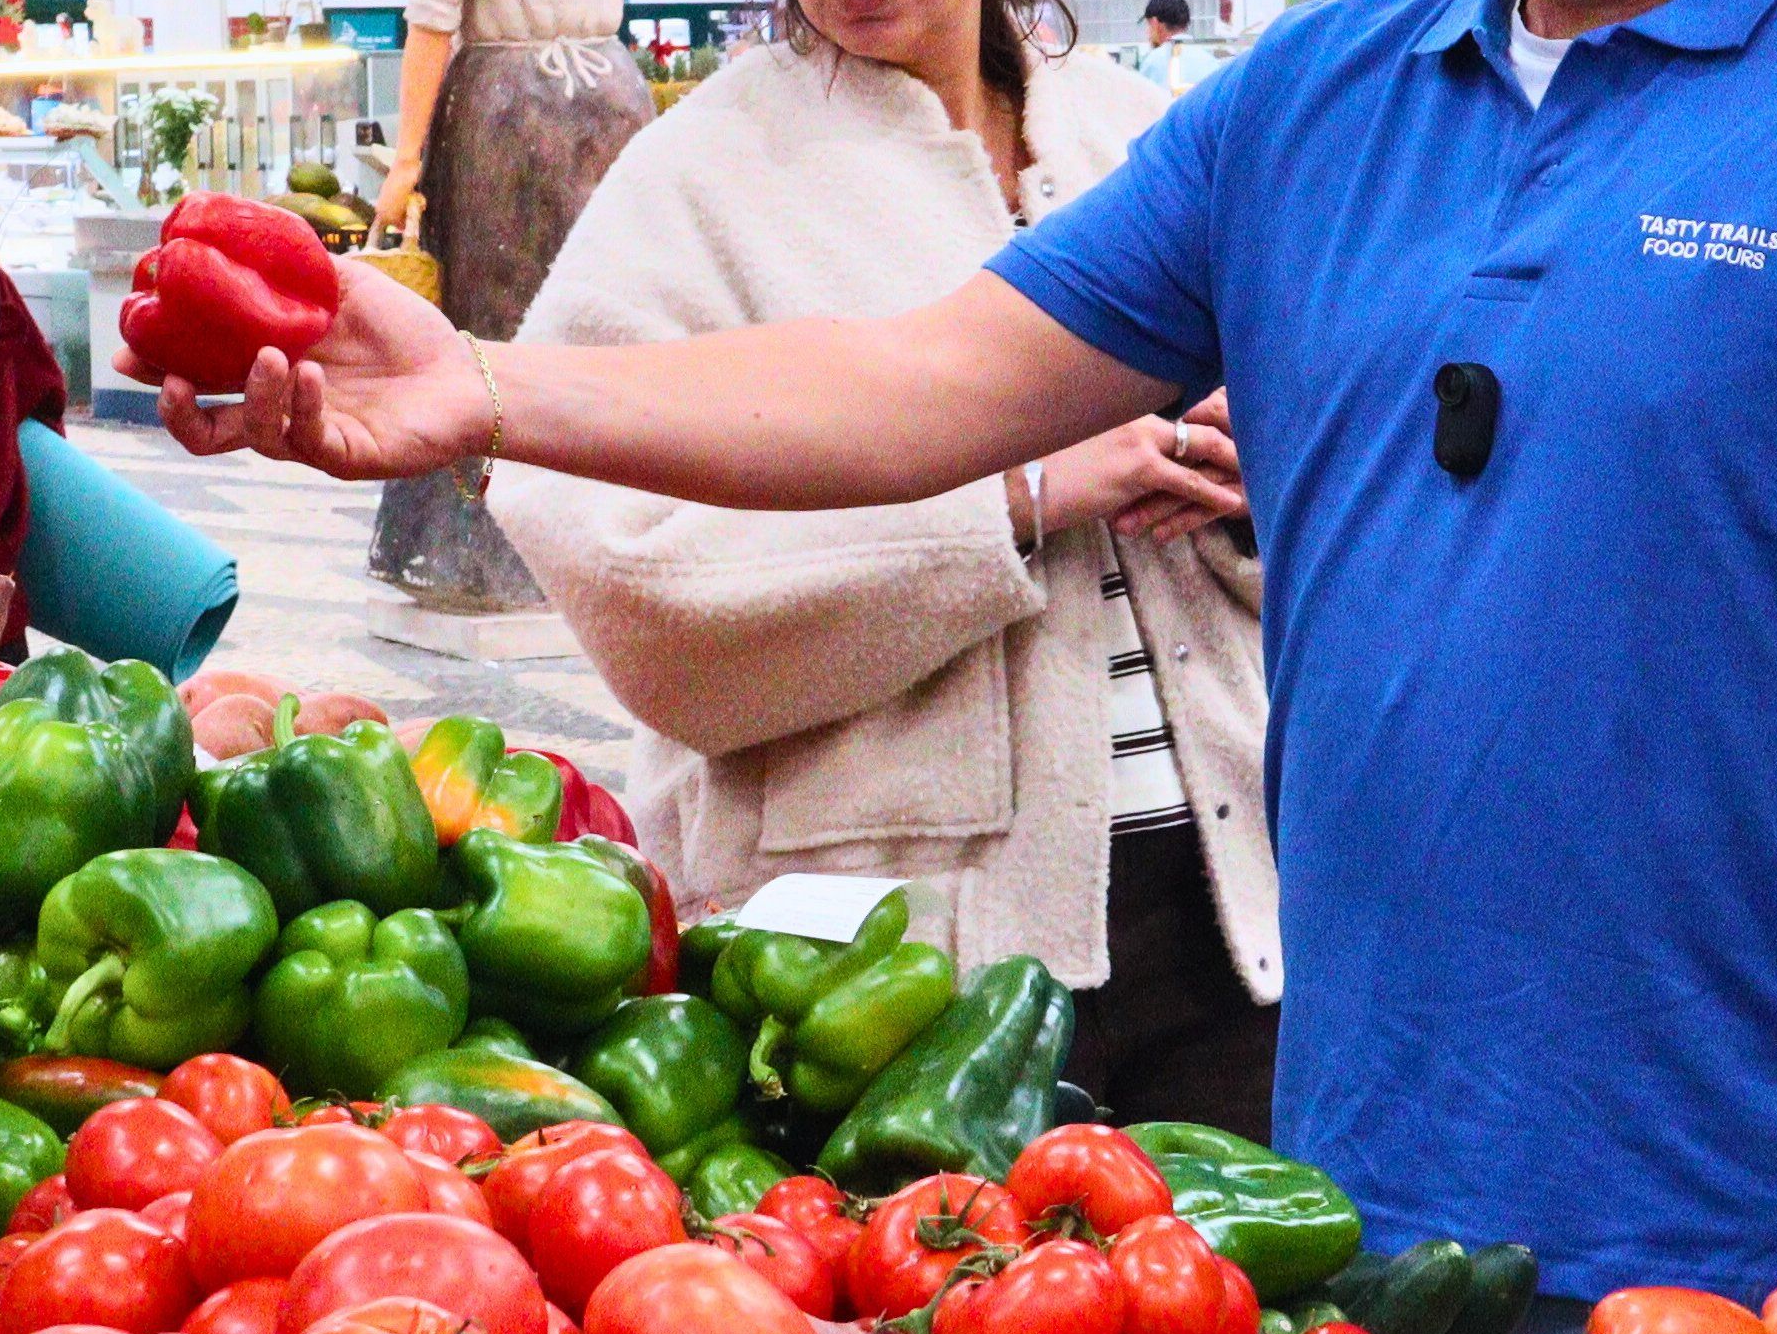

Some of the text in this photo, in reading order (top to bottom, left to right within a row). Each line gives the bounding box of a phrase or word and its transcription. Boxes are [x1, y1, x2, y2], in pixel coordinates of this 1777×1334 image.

[1639, 214, 1707, 238] TASTY
[1642, 237, 1767, 270] FOOD TOURS
